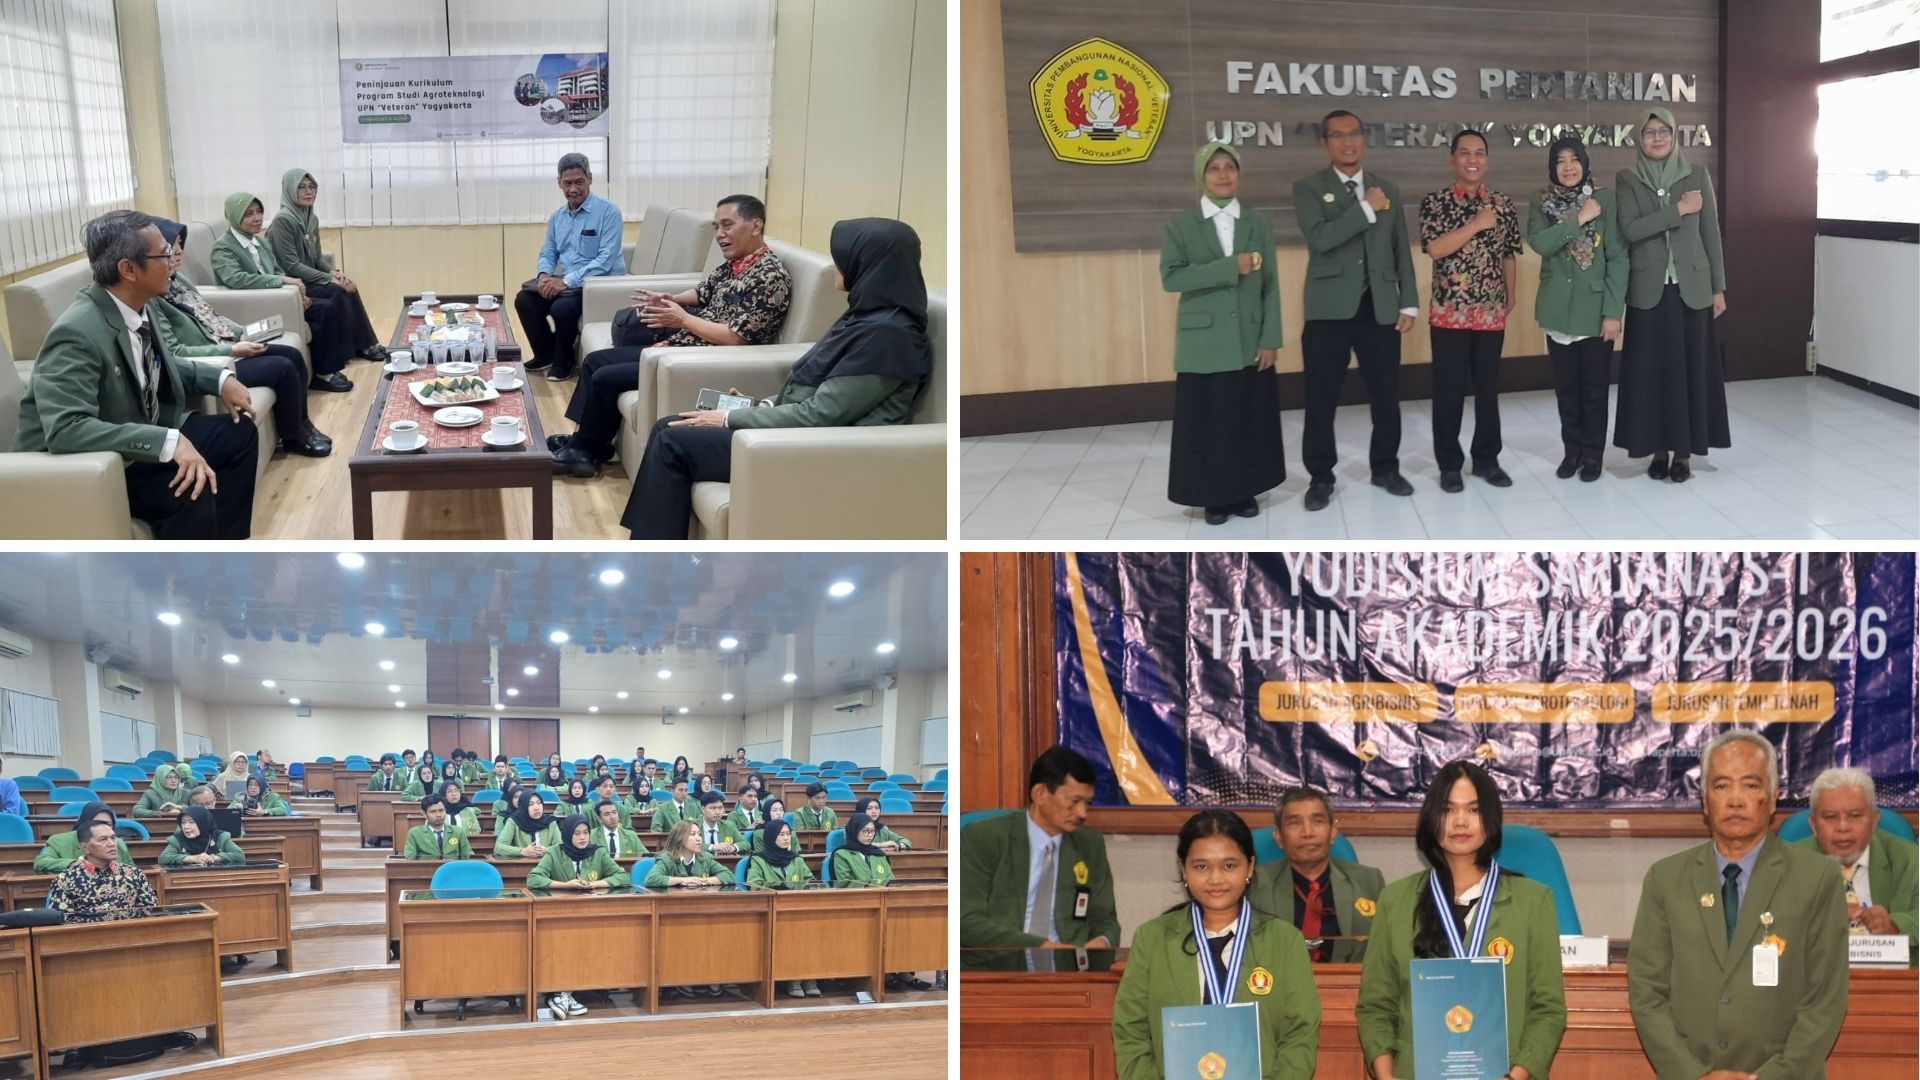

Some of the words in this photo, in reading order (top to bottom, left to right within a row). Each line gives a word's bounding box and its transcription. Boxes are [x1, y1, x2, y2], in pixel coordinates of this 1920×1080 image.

[1050, 52, 1116, 82] PEMBANGUNAN
[1117, 56, 1154, 91] NASIONAL
[356, 80, 405, 89] Peninjauan
[408, 79, 453, 87] Kurikulum
[356, 93, 394, 101] Program
[397, 91, 420, 99] Studi
[423, 89, 485, 99] Agroteknologi
[1226, 60, 1458, 99] FAKULTAS
[1479, 67, 1697, 103] PERTANIAN
[357, 104, 374, 112] UPN
[422, 102, 472, 111] Yogyakarta
[1043, 82, 1064, 139] UNIVERSITAS
[1206, 120, 1284, 147] UPN
[1077, 145, 1133, 158] YOGYAKARTA
[1524, 551, 1725, 600] SARJANA
[1204, 607, 1357, 662] TAHUN
[1374, 609, 1608, 663] AKADEMIK
[1622, 606, 1888, 663] 2025/2026
[1849, 939, 1896, 948] JURUSAN
